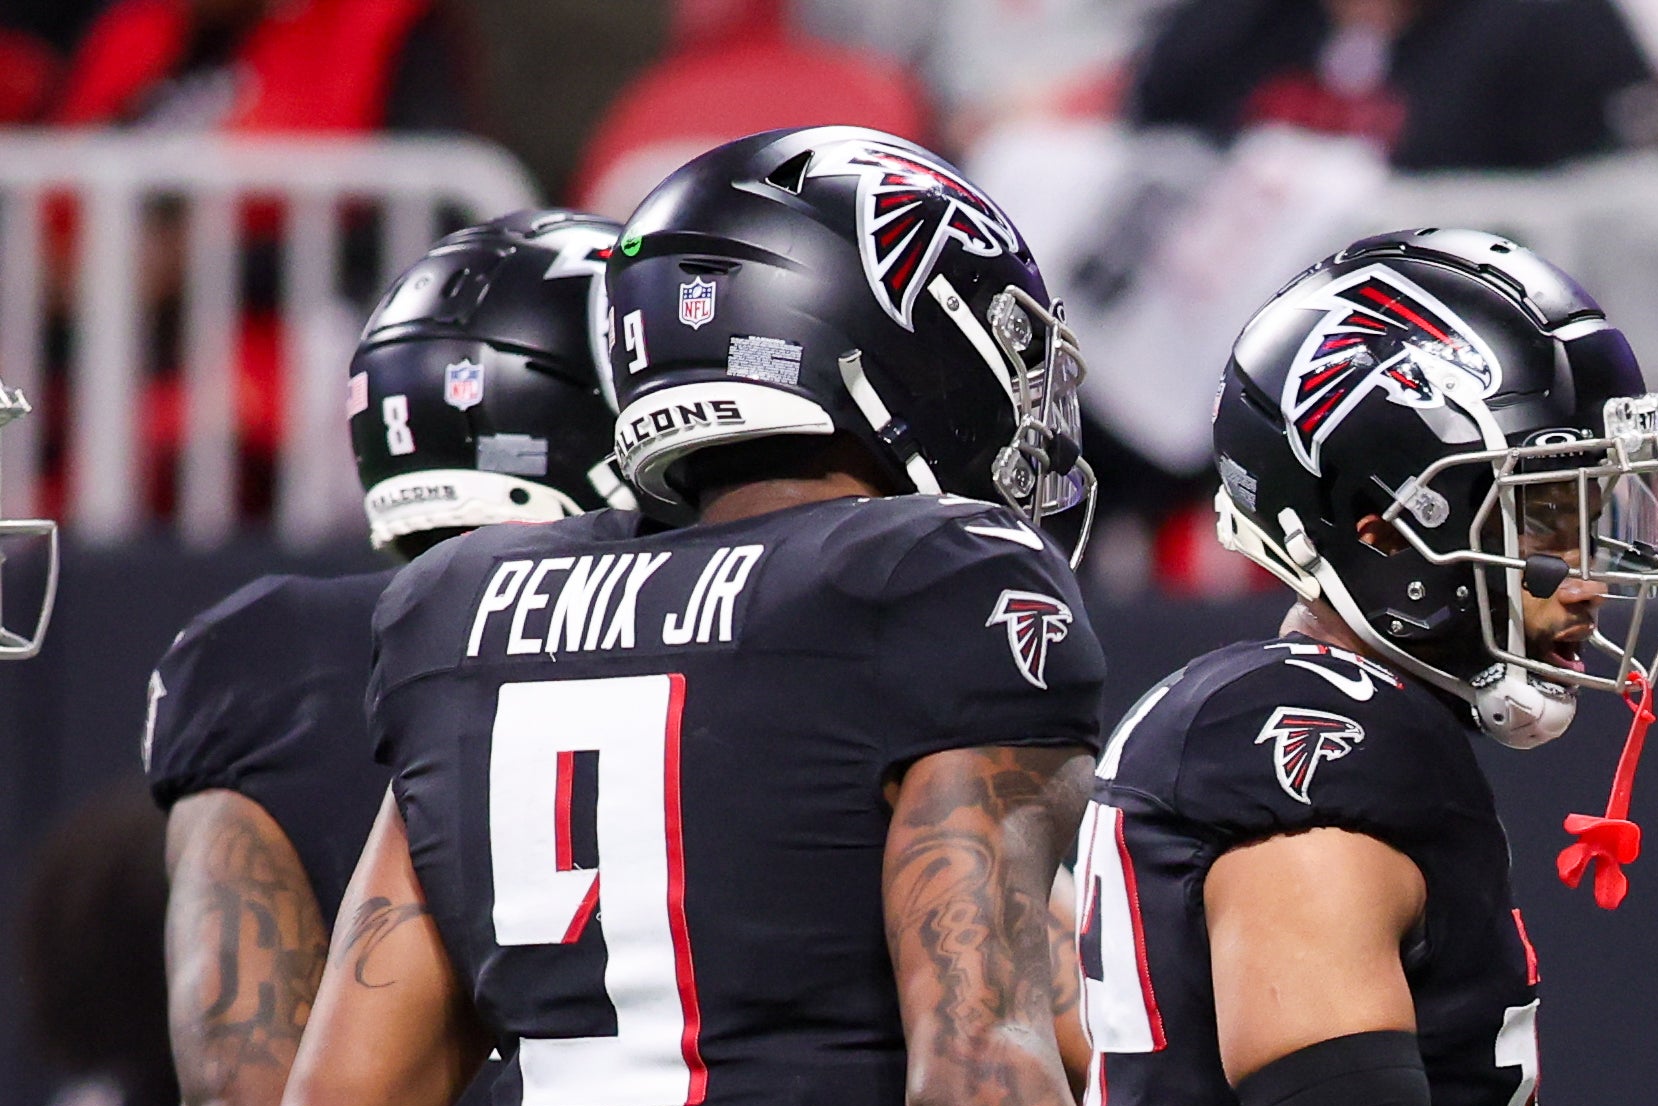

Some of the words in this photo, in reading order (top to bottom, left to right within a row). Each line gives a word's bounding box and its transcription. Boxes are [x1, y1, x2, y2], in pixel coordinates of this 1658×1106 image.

[623, 309, 651, 375] 9
[684, 300, 709, 320] NFL
[382, 394, 416, 456] 8
[466, 551, 673, 658] PENIX
[662, 544, 765, 645] JR
